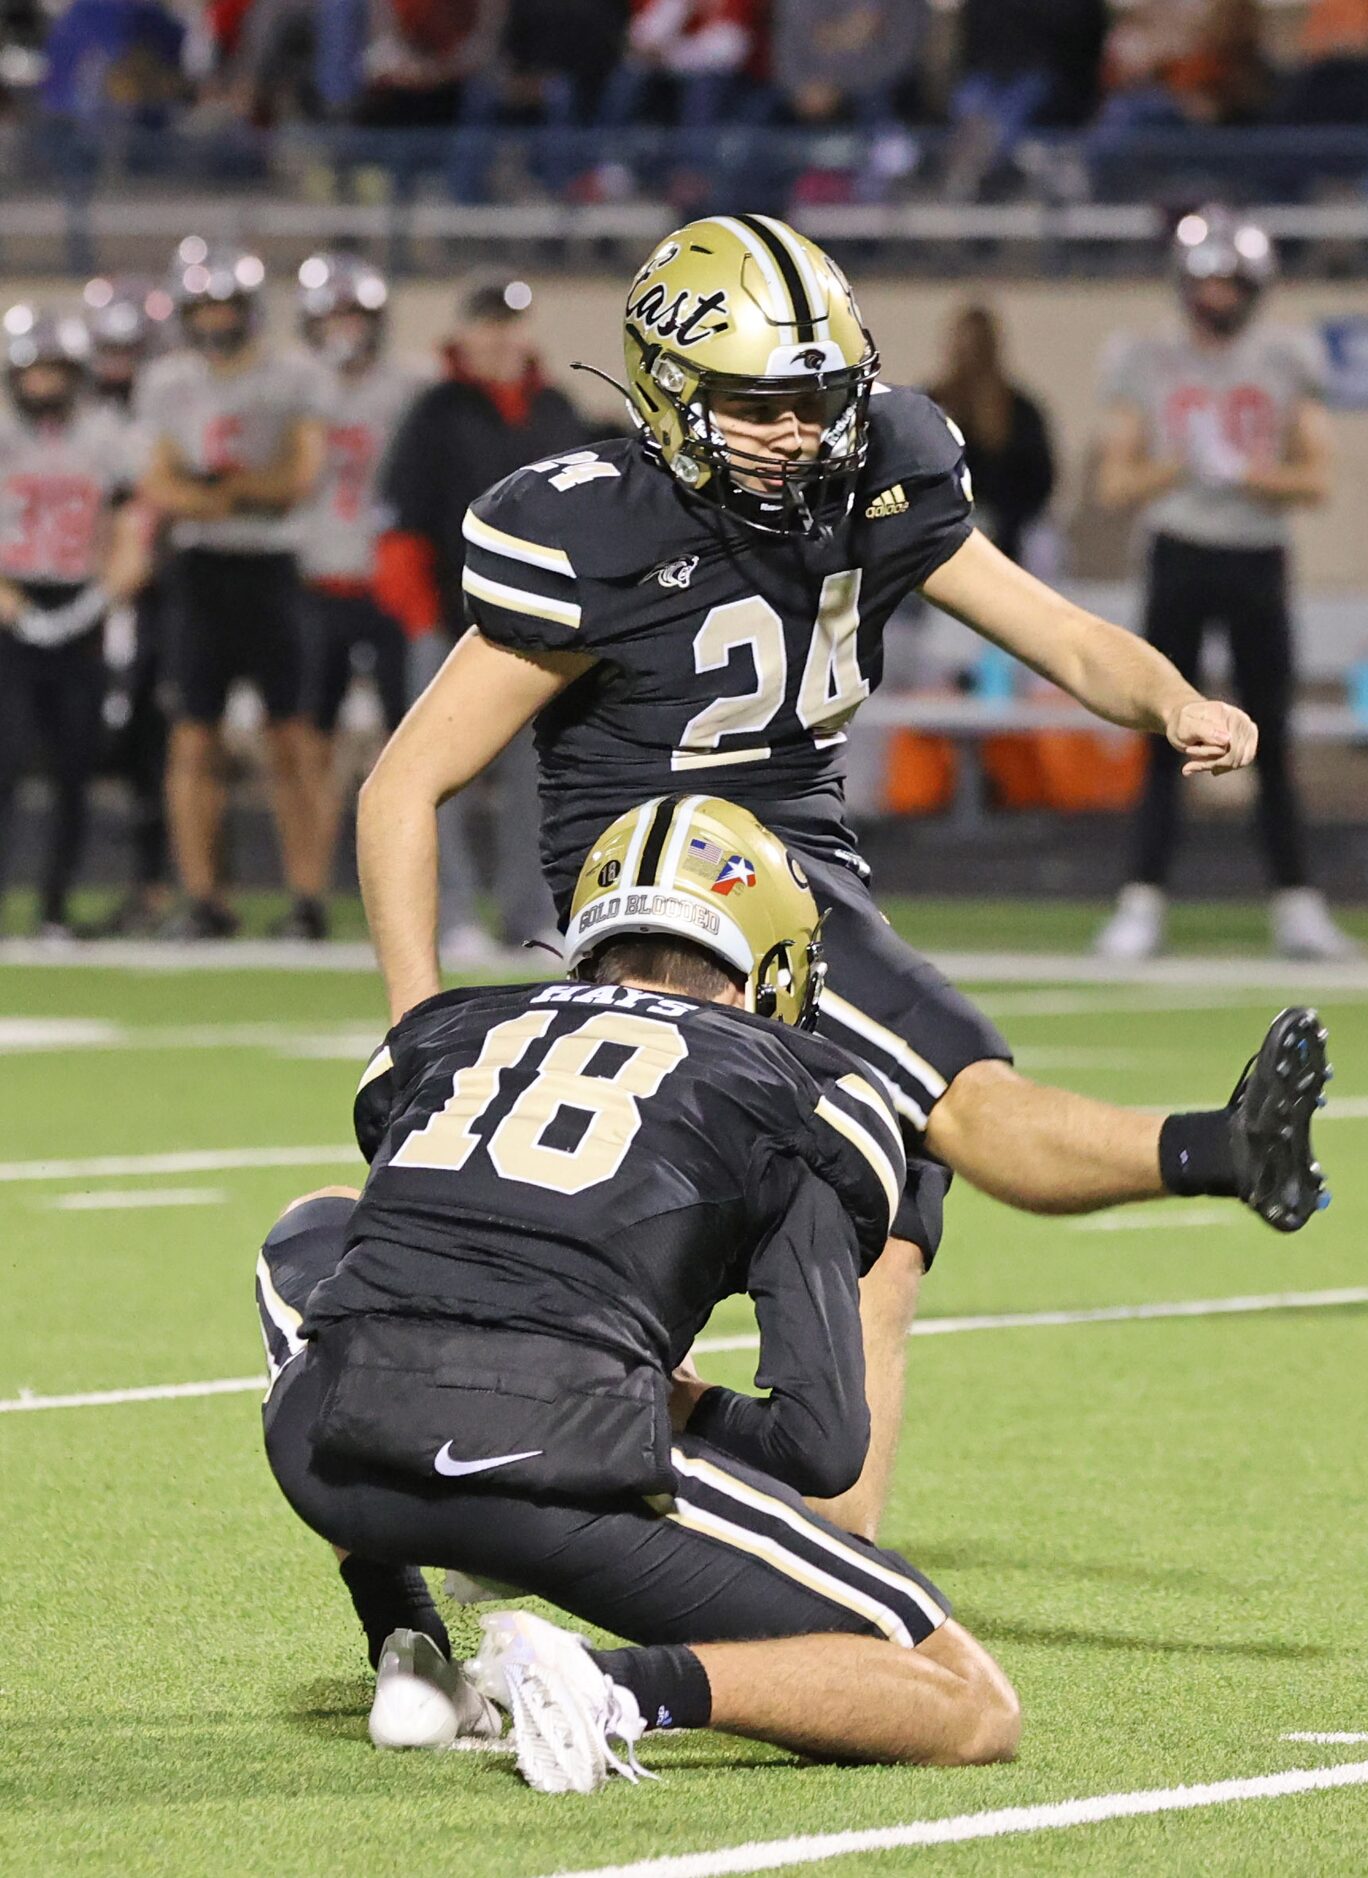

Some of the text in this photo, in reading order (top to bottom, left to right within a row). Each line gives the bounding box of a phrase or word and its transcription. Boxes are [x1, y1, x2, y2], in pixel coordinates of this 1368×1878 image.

[626, 241, 730, 346] East
[671, 568, 870, 772] 24
[601, 861, 617, 885] 18
[579, 894, 720, 936] GOLD BLOODED
[530, 985, 699, 1017] HAYS
[388, 1010, 690, 1196] 18
